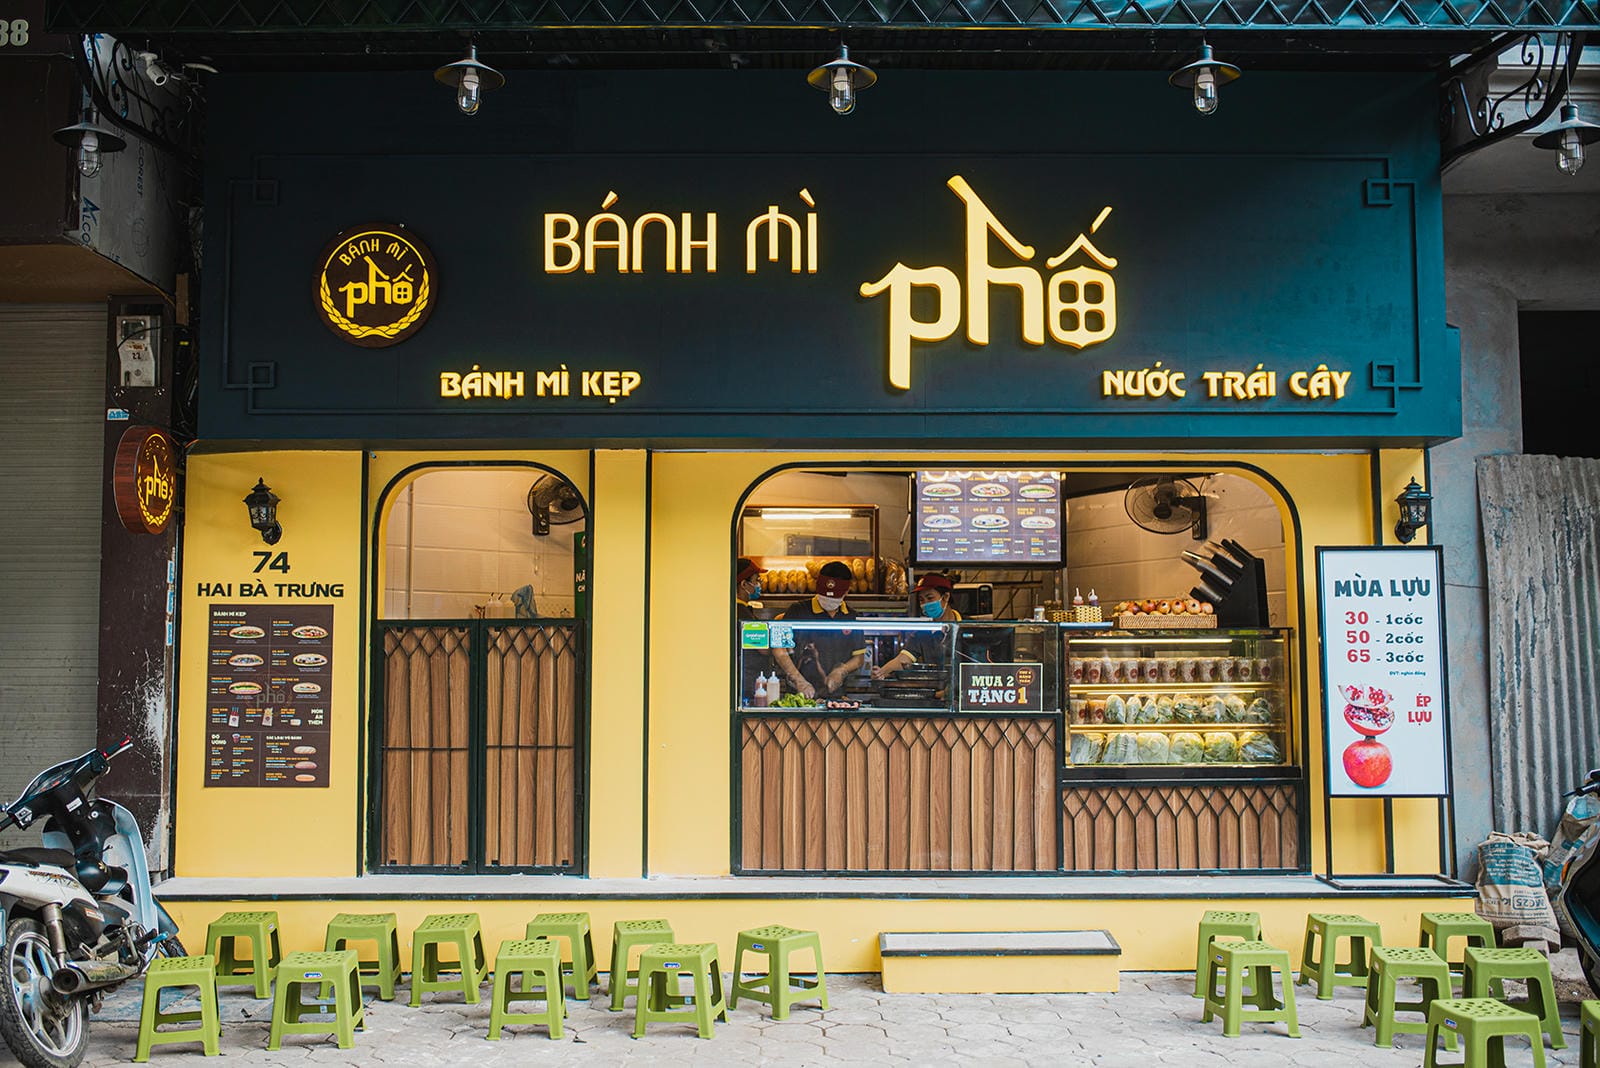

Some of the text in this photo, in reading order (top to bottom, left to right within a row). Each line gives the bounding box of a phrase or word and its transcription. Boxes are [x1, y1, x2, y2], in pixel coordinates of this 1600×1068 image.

[544, 188, 818, 274] BÁNH MÌ
[339, 238, 408, 267] BÁNH MÌ
[338, 256, 415, 318] phố
[860, 176, 1117, 390] phố
[441, 364, 641, 403] BÁNH MÌ KẸP
[1103, 362, 1351, 399] NƯỚC TRÁI CÂY
[253, 551, 291, 574] 74
[197, 579, 344, 598] HAI BÀ TRƯNG
[1334, 573, 1431, 602] MÙA LỰU
[1345, 611, 1369, 625] 30
[1386, 612, 1423, 625] 1cốc
[1346, 630, 1370, 644] 50
[1385, 632, 1424, 644] 2cốc
[1347, 649, 1371, 663] 65
[1385, 651, 1424, 663] 3cốc
[971, 675, 1015, 687] MUA 2
[967, 686, 1028, 706] TẶNG 1
[1416, 693, 1432, 707] ÉP
[1408, 710, 1432, 726] LỰU
